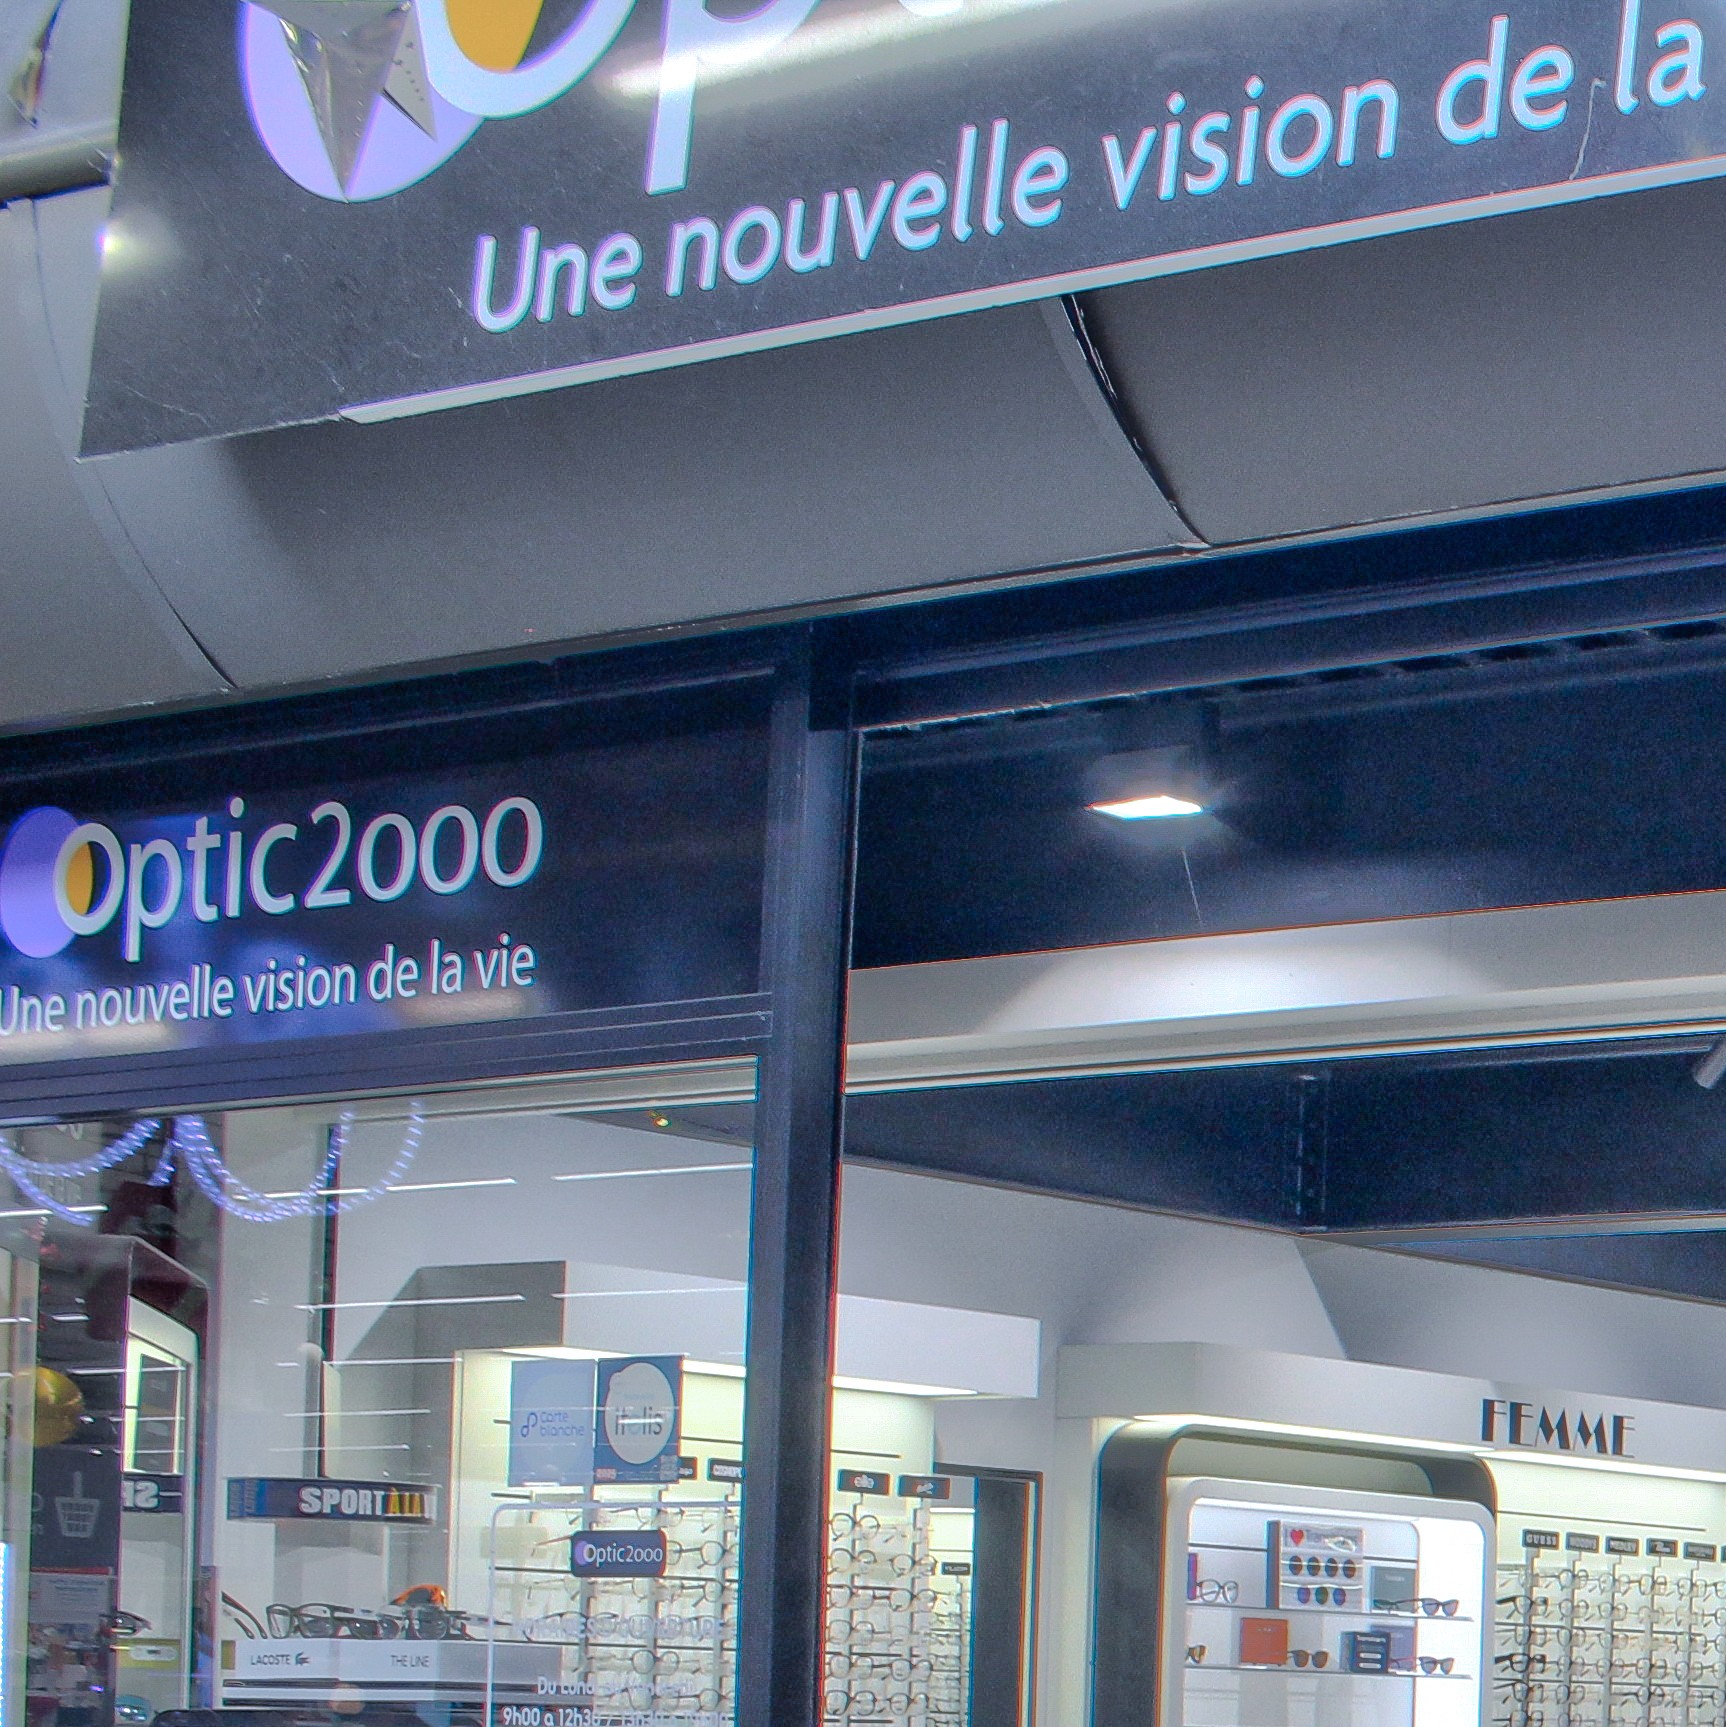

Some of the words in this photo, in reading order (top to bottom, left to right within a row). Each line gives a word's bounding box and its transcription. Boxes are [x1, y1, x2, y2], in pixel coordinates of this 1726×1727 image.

[472, 225, 644, 334] Une
[664, 117, 1070, 297] nouvelle
[1101, 75, 1399, 212] vision
[1435, 13, 1574, 148] de
[1613, 0, 1706, 116] la
[53, 796, 544, 963] Optic2000
[0, 984, 67, 1038] Une
[75, 963, 235, 1032] nouvelle
[243, 954, 357, 1015] vision
[367, 943, 421, 1002] de
[430, 937, 465, 995] la
[473, 931, 537, 990] vie
[1481, 1398, 1636, 1459] FEMME
[298, 1484, 385, 1516] SPORT
[583, 1543, 664, 1567] Optic2000
[250, 1653, 291, 1667] LACOSTE
[390, 1655, 408, 1667] THE
[409, 1655, 430, 1668] LINE
